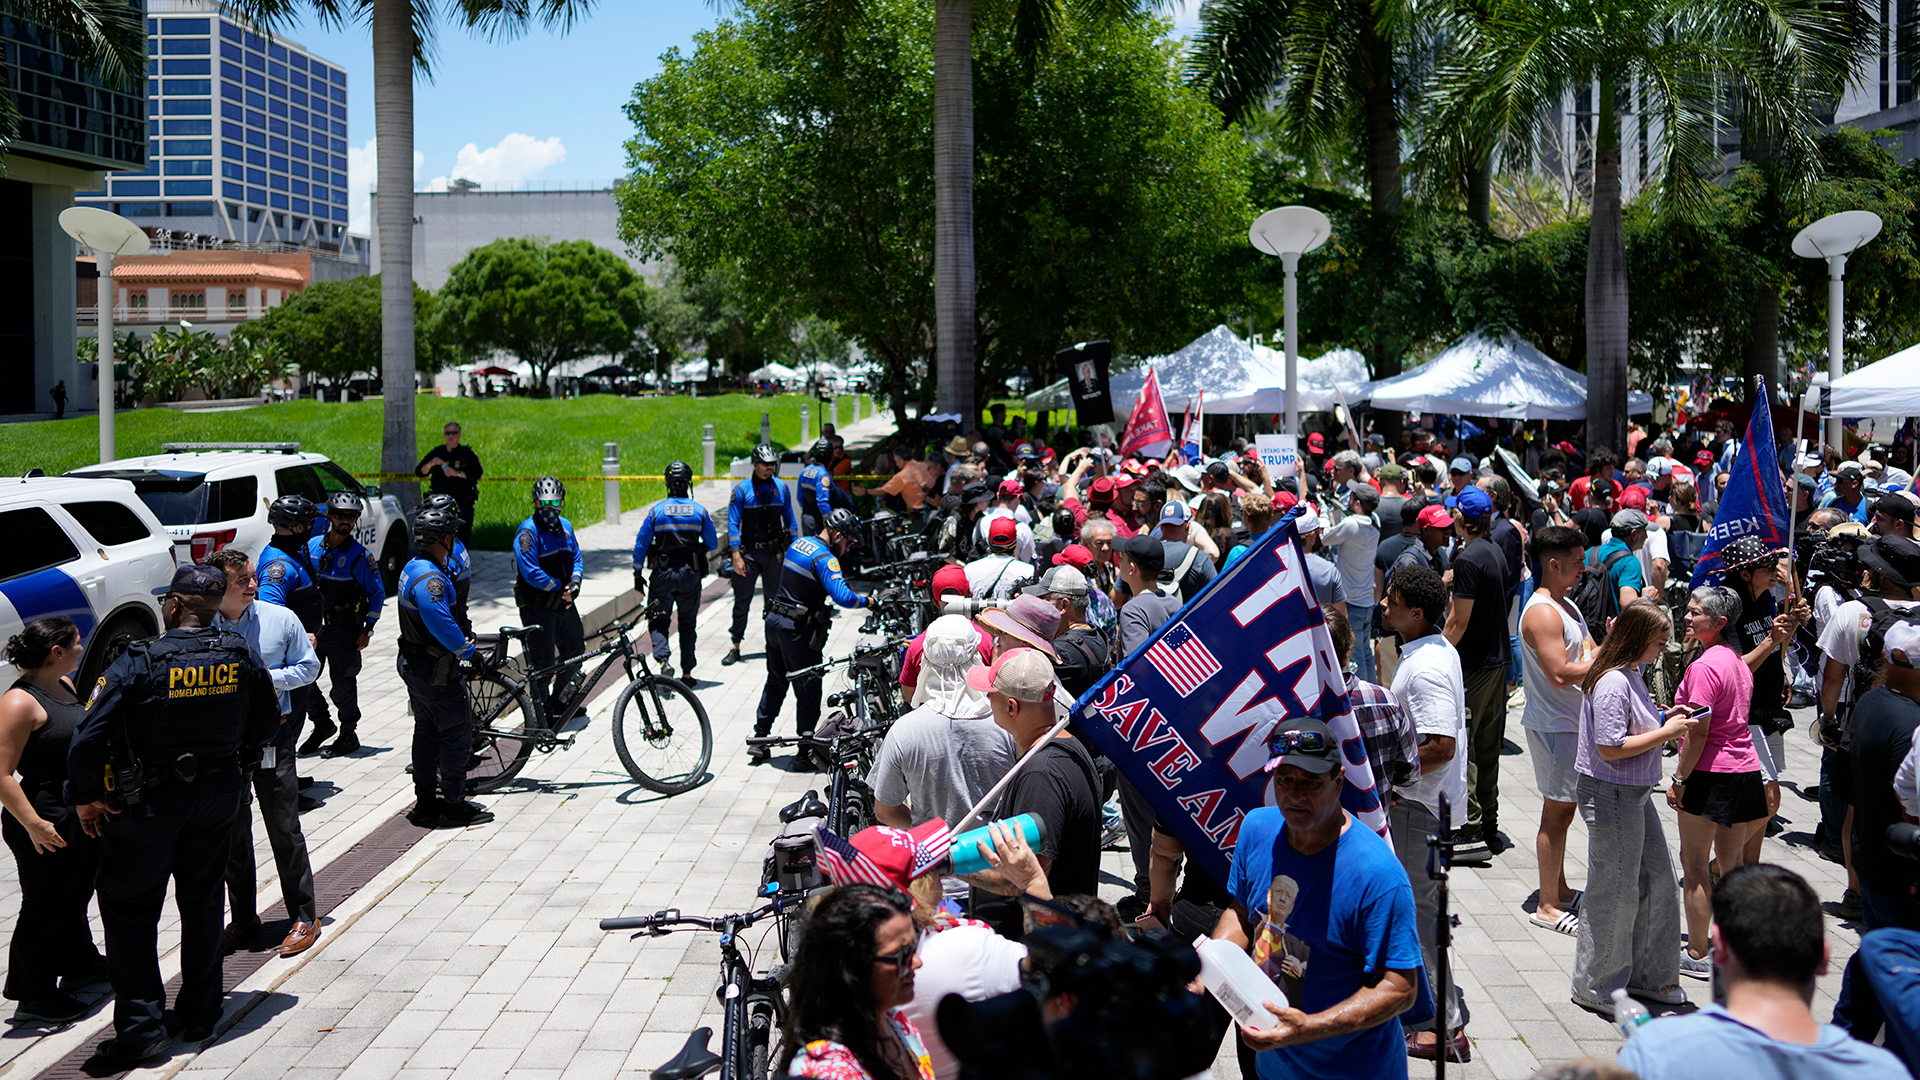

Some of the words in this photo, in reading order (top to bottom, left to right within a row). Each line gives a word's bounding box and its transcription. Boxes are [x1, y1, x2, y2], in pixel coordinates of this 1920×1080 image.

[1261, 454, 1295, 465] TRUMP
[666, 505, 692, 514] POLICE
[169, 662, 239, 689] POLICE
[169, 686, 207, 699] HOMELAND
[208, 684, 238, 696] SECURITY
[1092, 674, 1201, 790] SAVE
